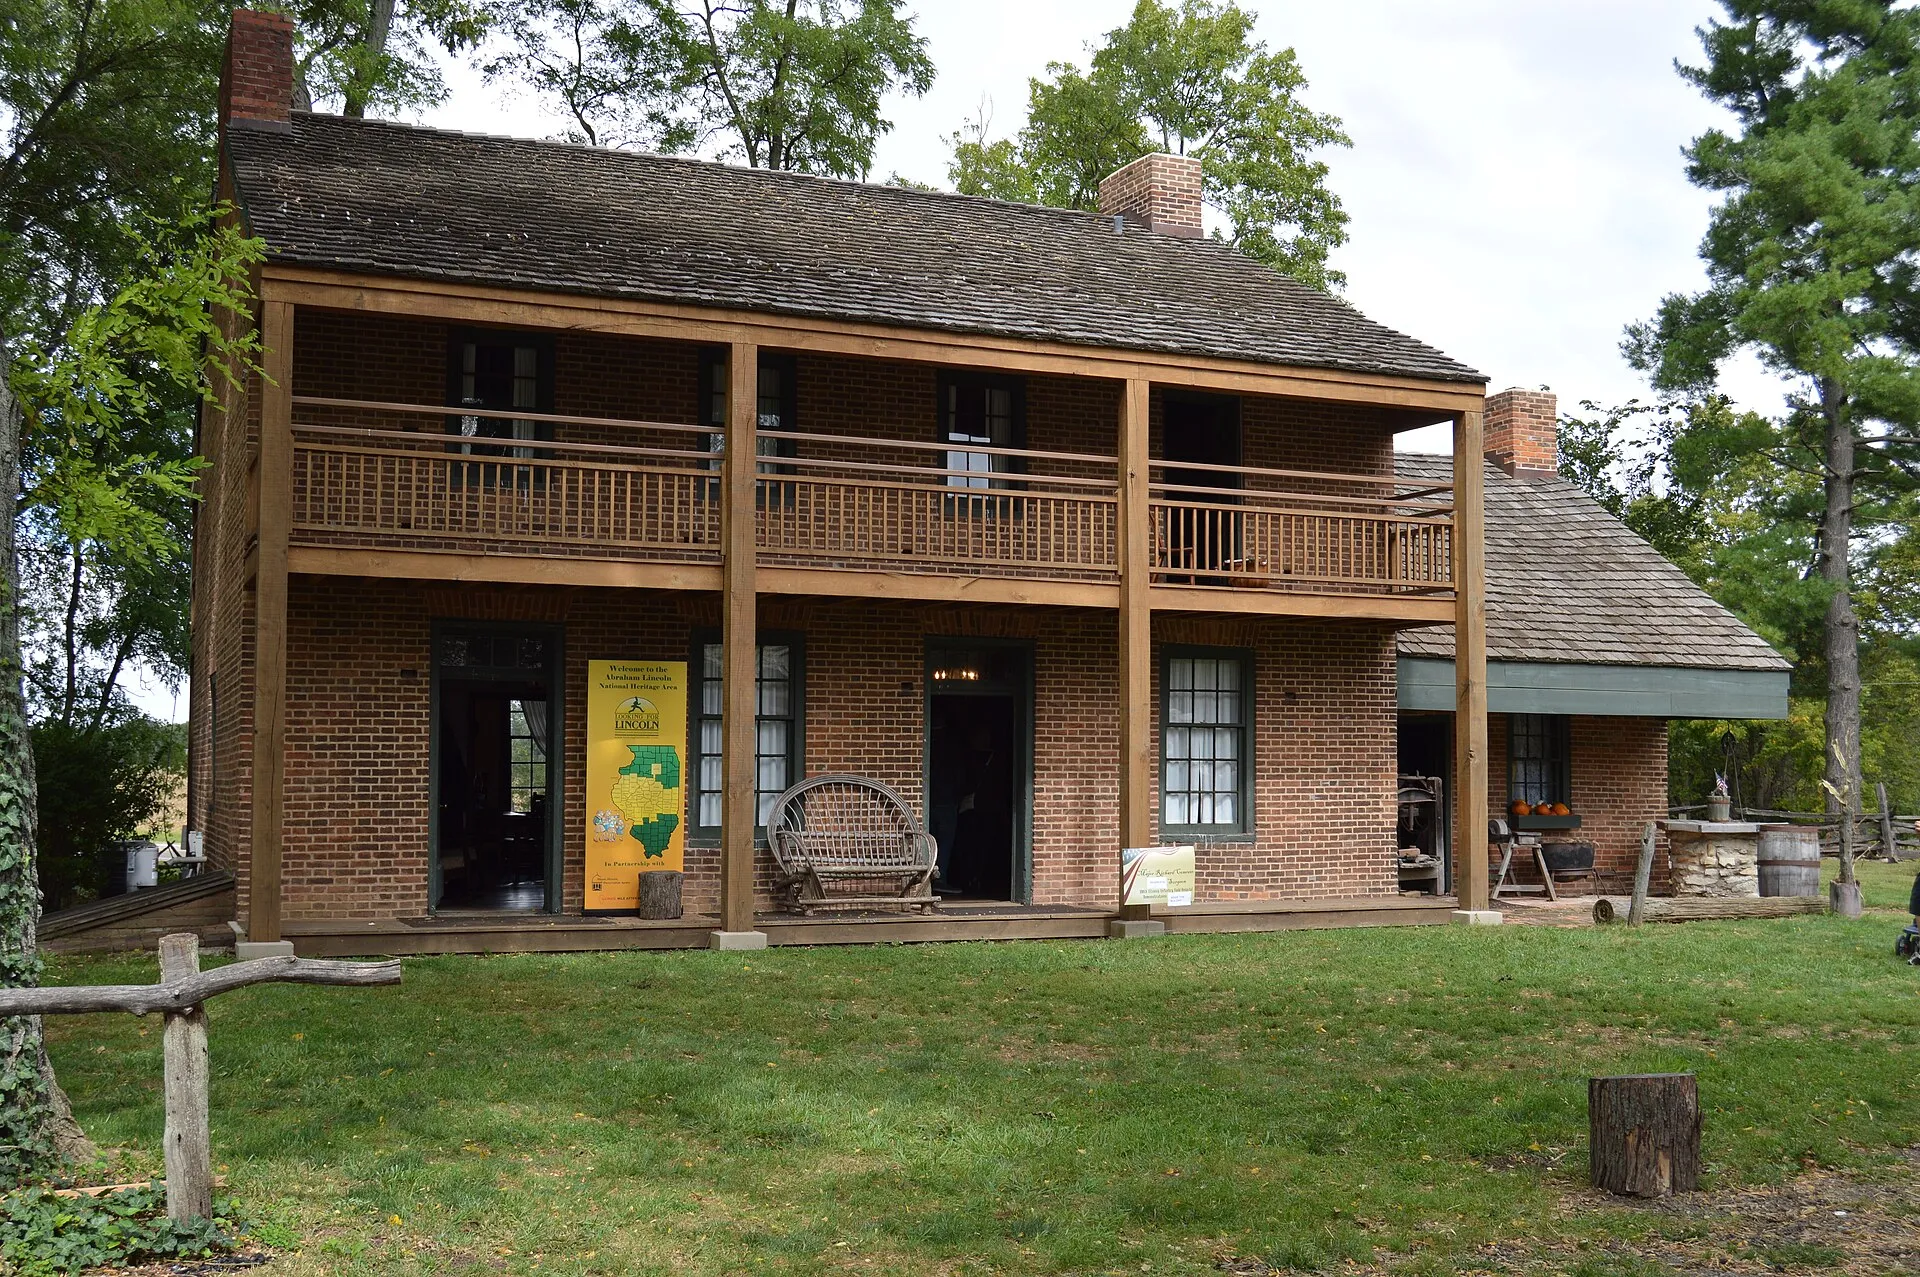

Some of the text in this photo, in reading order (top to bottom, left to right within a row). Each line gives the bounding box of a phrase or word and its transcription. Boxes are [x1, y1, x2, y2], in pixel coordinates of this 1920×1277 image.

[609, 665, 645, 673] Welcome
[642, 674, 672, 682] Lincoln
[630, 683, 661, 691] Heritage
[661, 683, 678, 691] Area
[615, 720, 659, 729] LINCOLN
